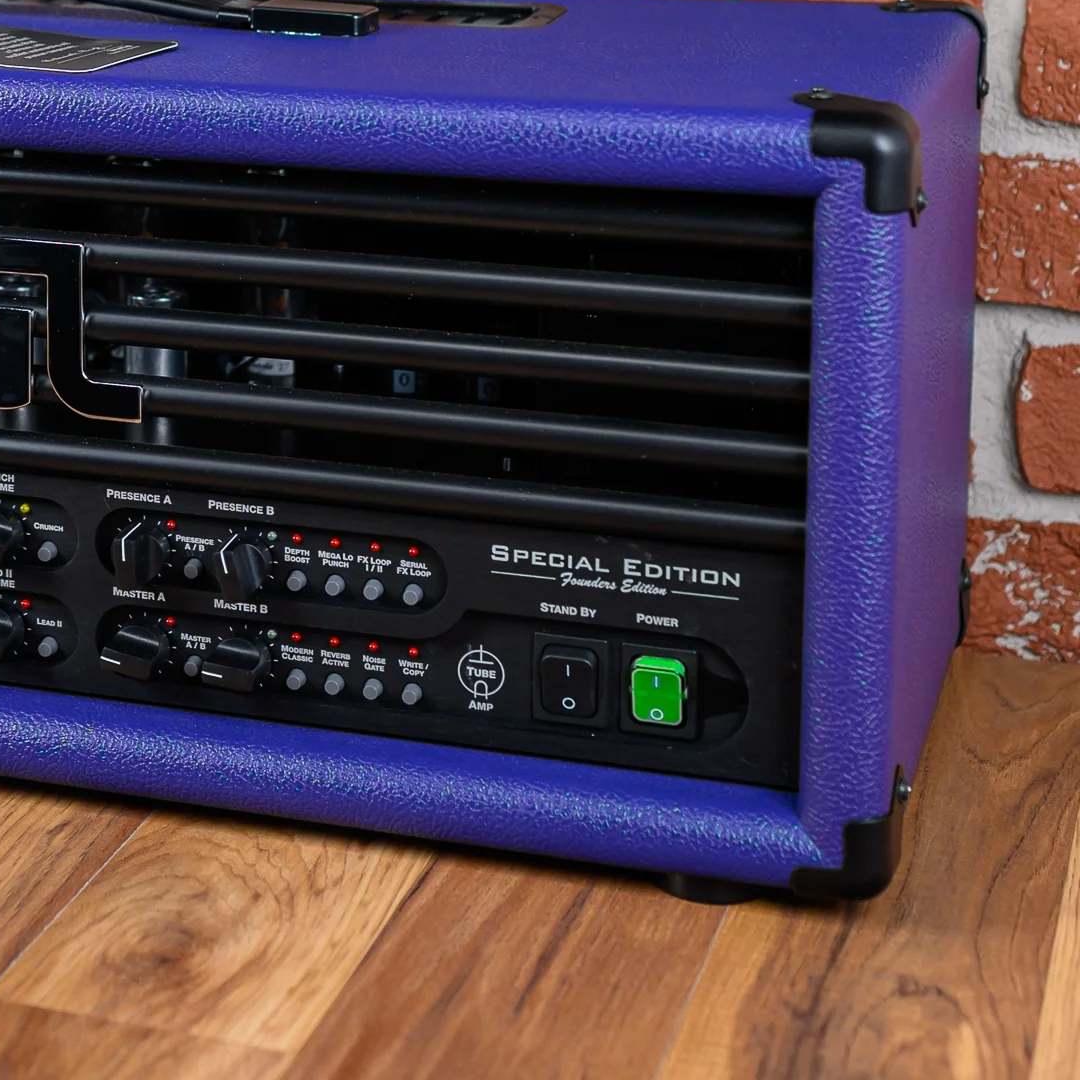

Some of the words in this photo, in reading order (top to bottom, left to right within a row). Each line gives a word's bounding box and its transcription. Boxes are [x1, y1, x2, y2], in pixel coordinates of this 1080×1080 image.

[106, 488, 160, 504] PRESENCE
[162, 493, 172, 505] A
[208, 499, 263, 515] PRESENCE
[266, 505, 275, 516] B
[33, 522, 64, 533] CRUNCH
[175, 534, 215, 546] PRESENCE
[284, 546, 310, 557] DEPTH
[318, 550, 341, 560] MEGA
[342, 553, 354, 562] LO
[284, 554, 310, 564] BOOST
[322, 558, 350, 568] PUNCH
[357, 555, 369, 564] FX
[370, 557, 392, 566] LOOP
[400, 560, 428, 570] SERIAL
[491, 544, 610, 573] SPECIAL
[623, 559, 741, 588] EDITION
[5, 568, 13, 579] II
[396, 566, 409, 575] FX
[410, 568, 432, 577] LOOP
[560, 572, 617, 591] Founders
[620, 579, 668, 597] Edition
[113, 587, 154, 601] MASTER
[156, 591, 166, 602] A
[213, 599, 256, 613] MASTER
[259, 603, 268, 615] B
[540, 602, 578, 617] STAND
[580, 606, 597, 619] BY
[36, 617, 56, 627] LEAD
[57, 620, 63, 628] II
[636, 613, 679, 628] POWER
[180, 632, 211, 644] MASTER
[281, 644, 314, 656] MODERN
[320, 649, 351, 660] REVERB
[281, 652, 314, 663] CLASSIC
[322, 657, 350, 668] ACTIVE
[362, 654, 386, 665] NOISE
[364, 662, 385, 672] GATE
[398, 659, 424, 669] WRITE
[402, 667, 425, 677] COPY
[466, 667, 497, 679] TUBE
[468, 700, 494, 712] AMP
